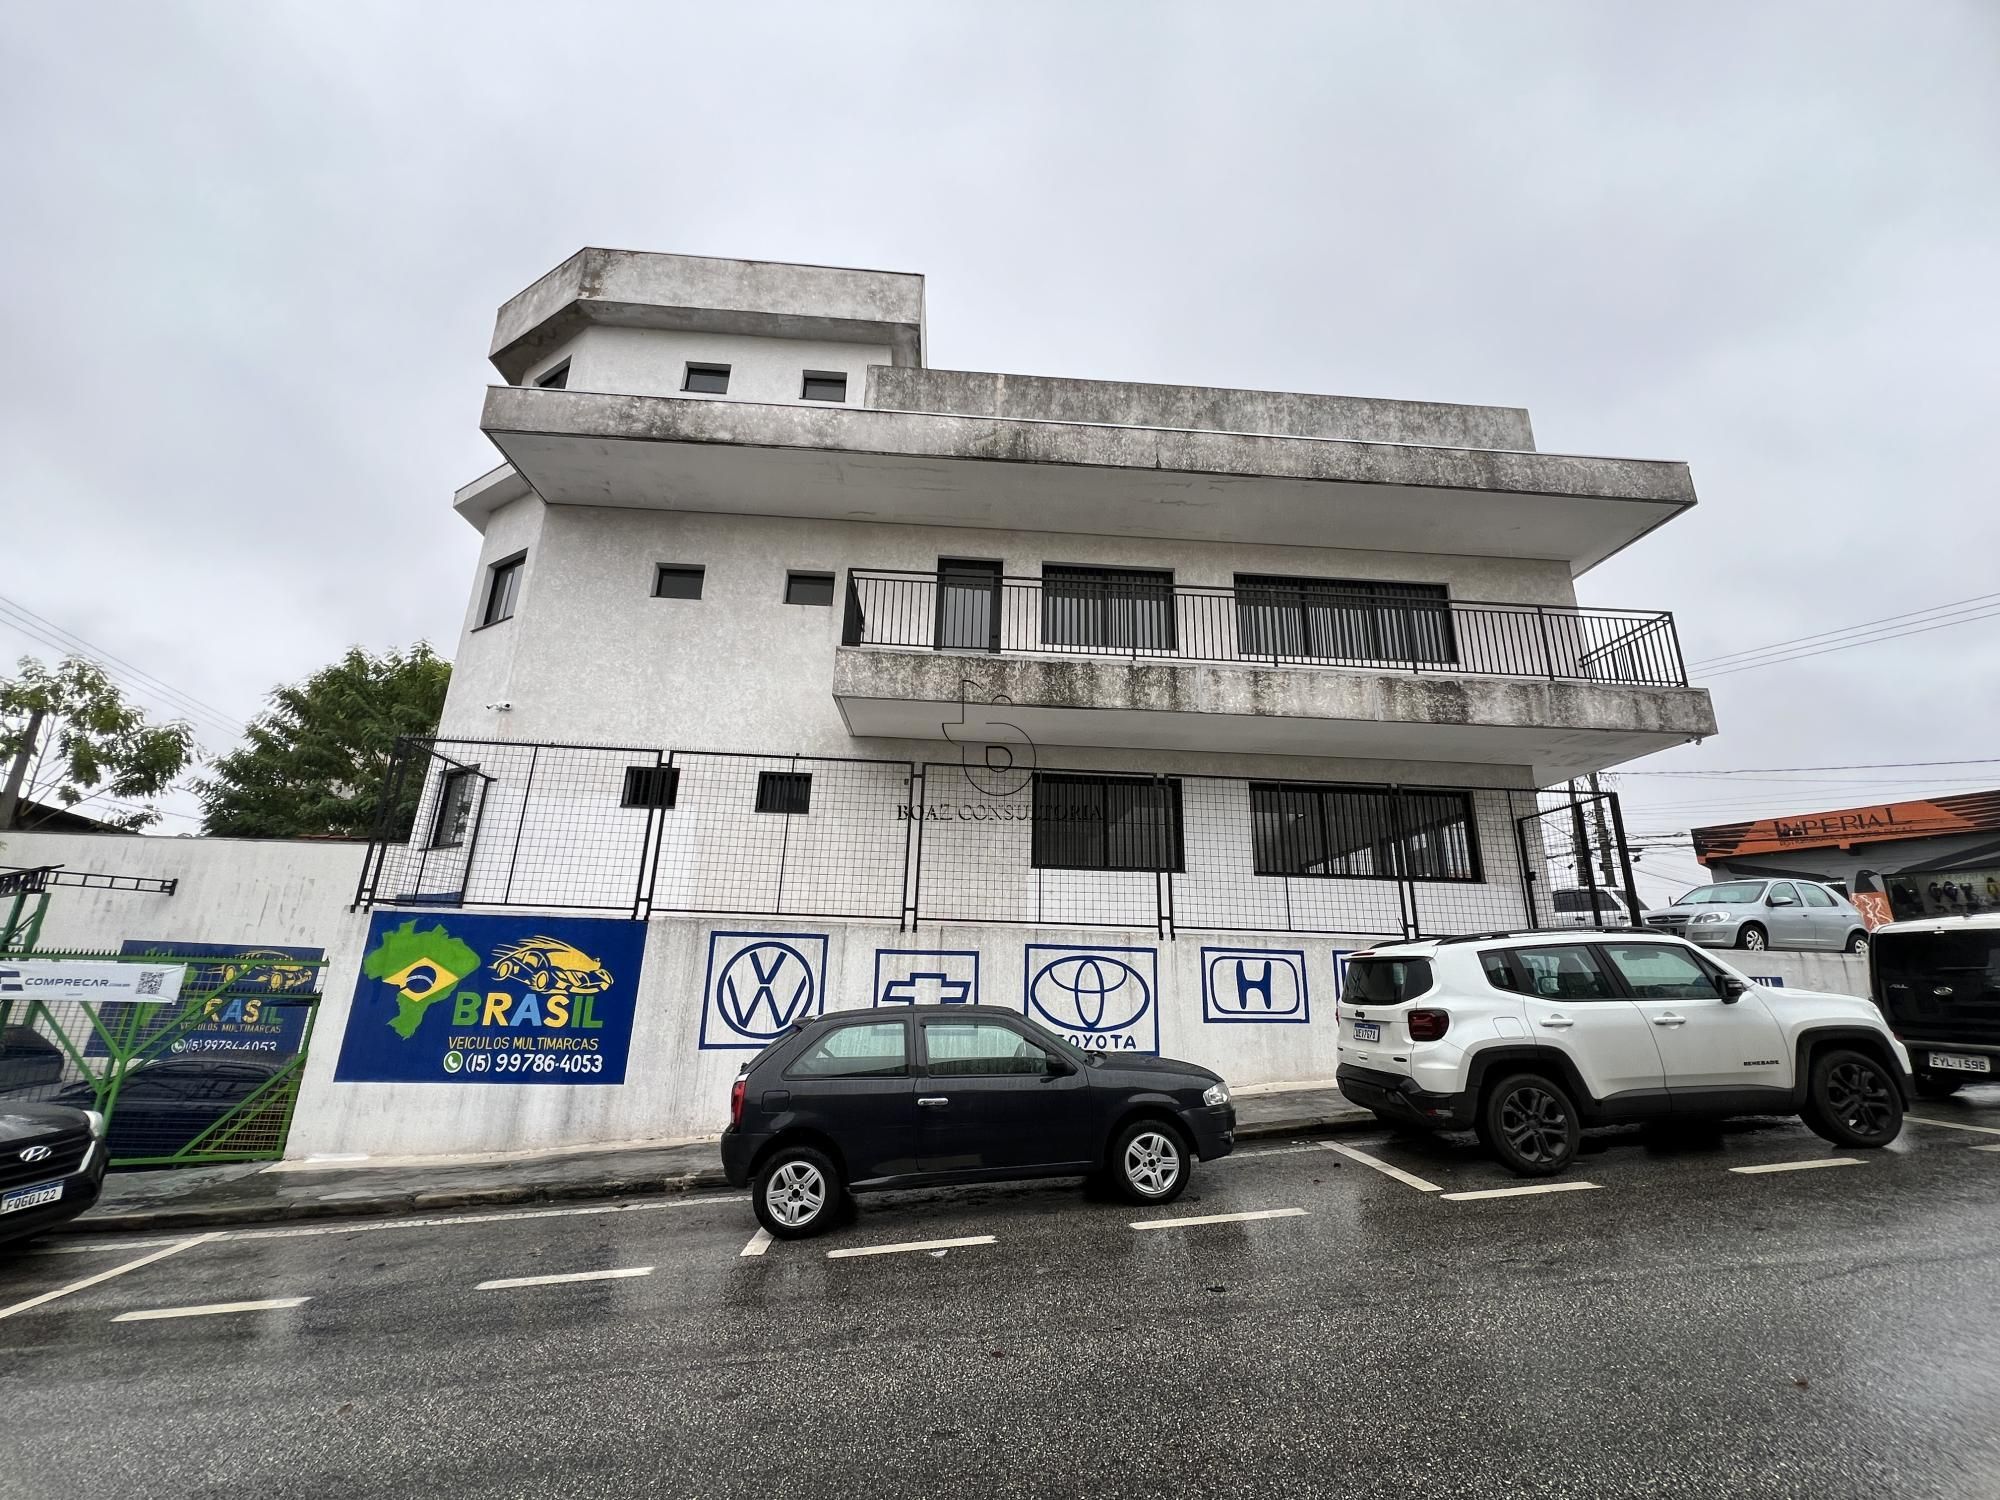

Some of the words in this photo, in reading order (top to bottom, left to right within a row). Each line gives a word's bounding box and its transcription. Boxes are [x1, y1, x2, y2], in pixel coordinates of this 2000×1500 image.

[452, 991, 604, 1028] BRASIL
[449, 1036, 510, 1050] VEICULOS
[512, 1037, 600, 1051] MULTIMARCAS
[465, 1053, 492, 1074] (15)
[495, 1053, 603, 1073] 99786-4053
